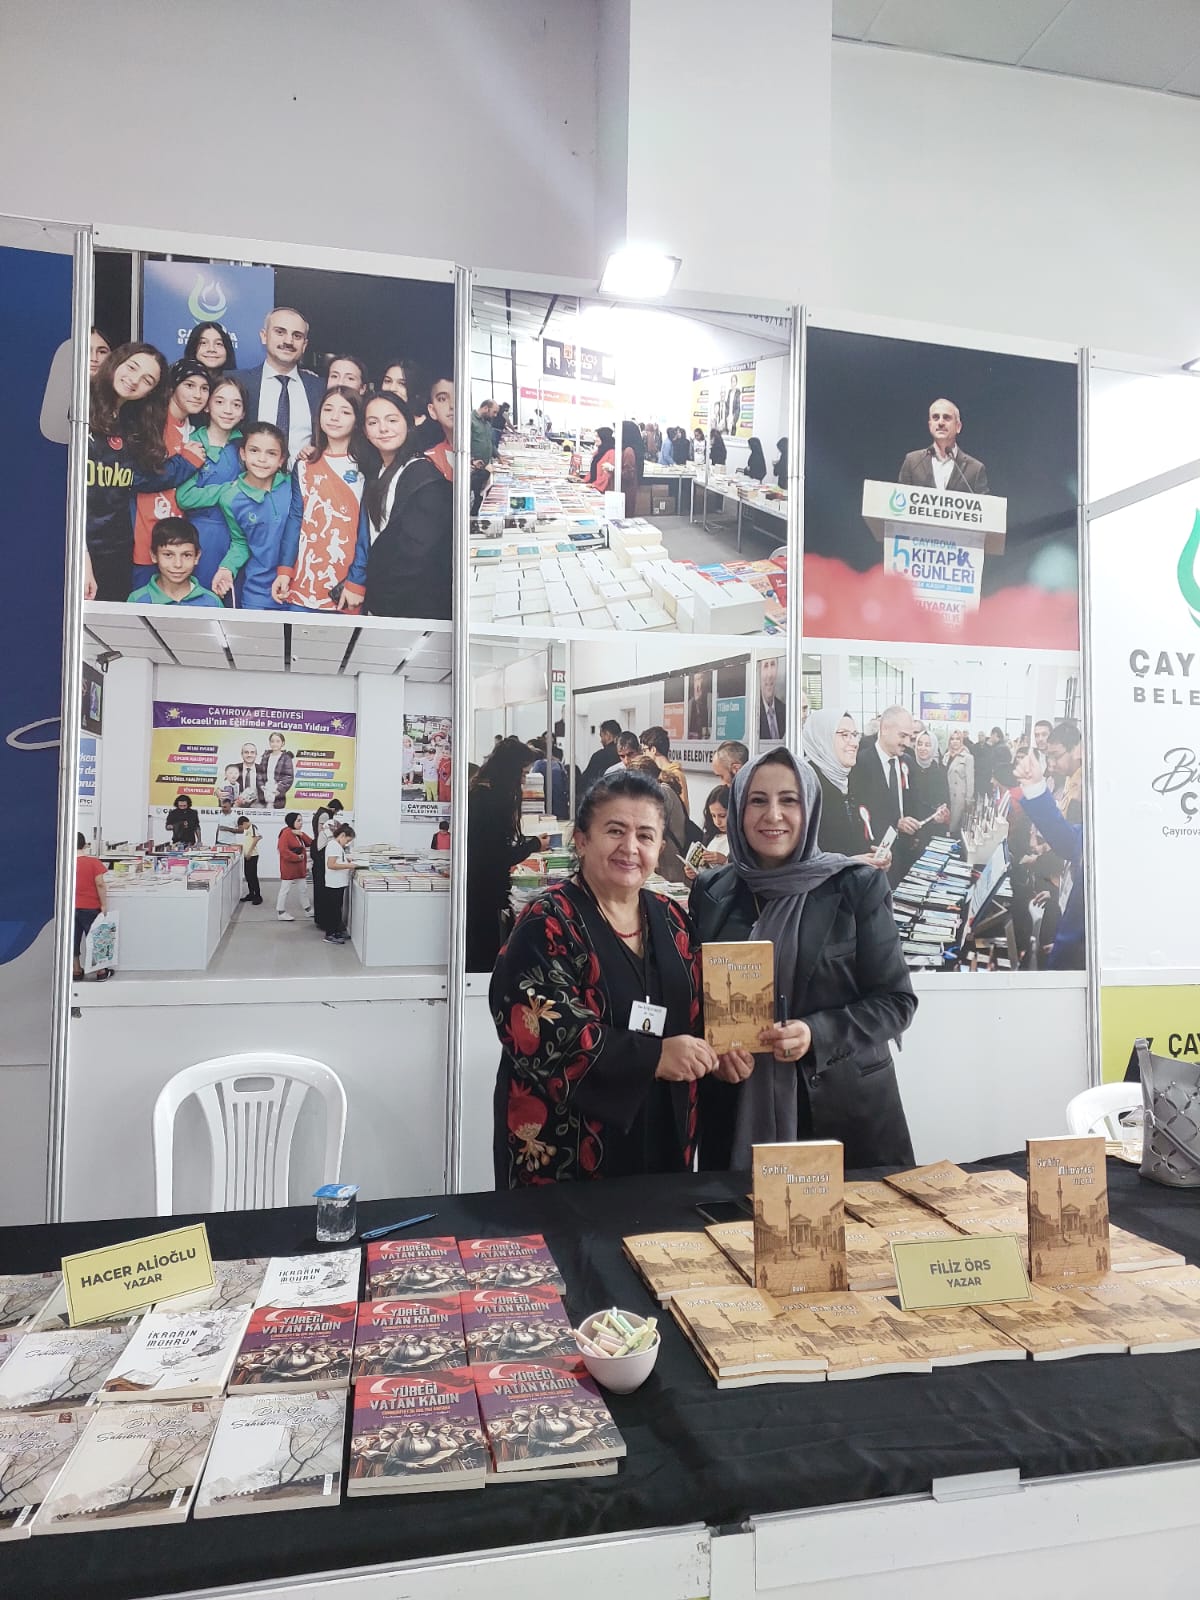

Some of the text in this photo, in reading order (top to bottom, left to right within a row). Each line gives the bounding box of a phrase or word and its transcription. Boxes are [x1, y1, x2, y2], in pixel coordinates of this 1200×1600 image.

[909, 492, 983, 512] ÇAYIROVA
[909, 506, 984, 524] BELEDİYESİ
[912, 537, 958, 551] ÇAYIROVA
[912, 548, 957, 566] KİTAP
[911, 563, 975, 584] GÜNLERİ
[1128, 648, 1196, 680] ÇAY
[208, 706, 252, 720] ÇAYIROVA
[180, 716, 227, 727] Kocaeli'nin
[267, 719, 303, 732] Parlayan
[683, 750, 717, 763] BELEDİYE
[81, 1247, 196, 1288] HACER ALİOĞLU
[929, 1257, 991, 1275] FİLİZ ÖRS
[123, 1272, 162, 1291] YAZAR
[946, 1276, 981, 1288] YAZAR
[494, 1380, 539, 1397] VATAN
[369, 1395, 416, 1412] VATAN
[419, 1392, 460, 1408] KADIN
